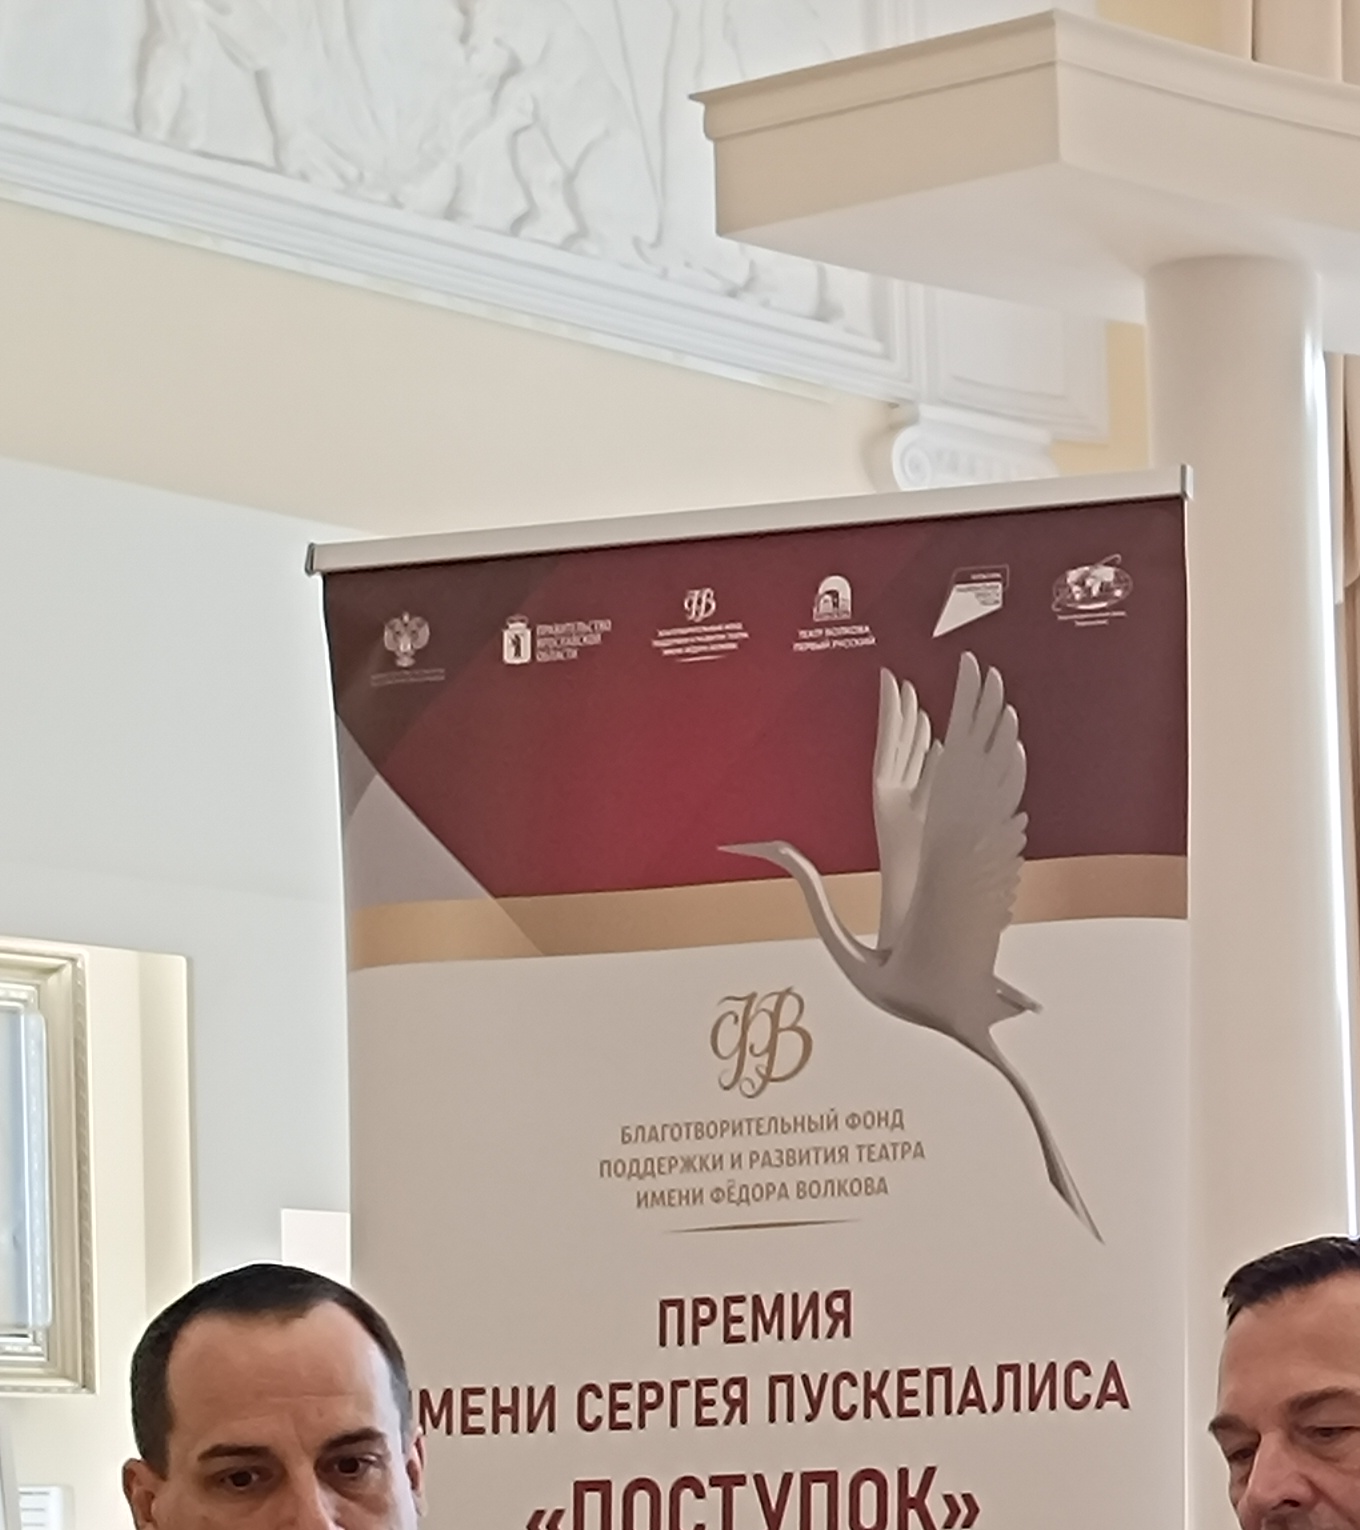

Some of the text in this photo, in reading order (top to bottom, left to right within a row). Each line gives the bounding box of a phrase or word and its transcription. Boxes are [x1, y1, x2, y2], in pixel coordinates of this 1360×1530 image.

[620, 1107, 906, 1145] БЛАГОТВОРИТЕЛЬНЫЙ ФОНД
[600, 1141, 926, 1180] ПОДДЕРЖКИ И РАЗВИТИЯ ТЕАТРА
[636, 1176, 889, 1209] ИМЕНИ ФЁДОРА ВОЛКОВА
[657, 1288, 853, 1348] ПРЕМИЯ
[409, 1359, 1130, 1436] МЕНИ СЕРГЕЯ ПУСКЕПАЛИСА
